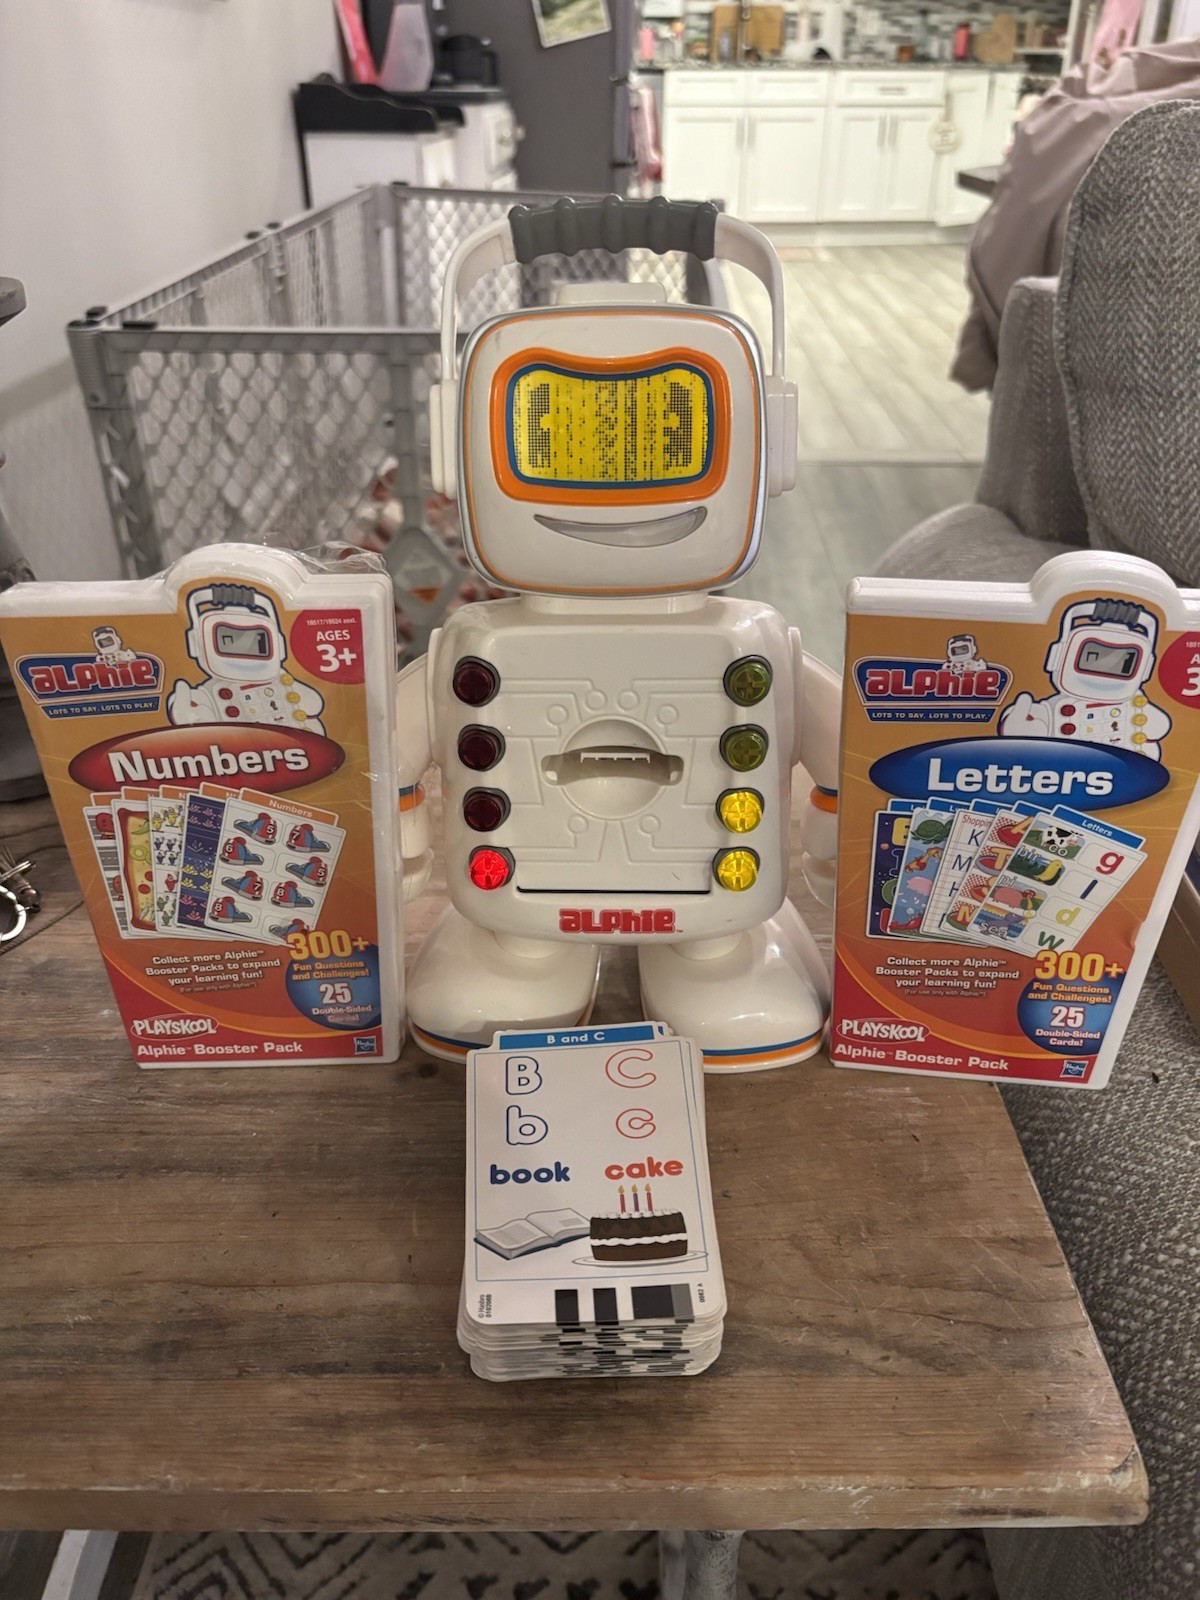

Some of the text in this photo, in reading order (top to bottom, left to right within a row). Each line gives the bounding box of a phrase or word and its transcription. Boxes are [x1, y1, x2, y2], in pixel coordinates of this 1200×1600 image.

[316, 629, 351, 641] AGES
[316, 644, 357, 672] 3+
[49, 707, 68, 715] LOTS
[101, 704, 120, 712] LOTS
[108, 744, 309, 783] Numbers
[927, 757, 1114, 796] Letters
[268, 799, 313, 819] Numbers
[266, 825, 274, 834] 5
[962, 814, 992, 828] Shoppin
[1081, 819, 1113, 837] Letters
[292, 831, 300, 839] 7
[967, 828, 984, 847] K
[225, 844, 233, 853] 6
[951, 854, 973, 873] M
[1095, 851, 1125, 875] g
[318, 868, 325, 877] 5
[254, 882, 261, 891] 7
[277, 888, 284, 897] 8
[214, 903, 222, 912] 8
[1055, 906, 1081, 927] d
[286, 929, 369, 960] 300+
[145, 959, 281, 976] Booster Packs to expand
[152, 955, 190, 965] Collect
[193, 953, 221, 962] more
[293, 960, 365, 971] Fun Questions
[887, 956, 927, 966] Collect
[930, 958, 960, 966] more
[1034, 950, 1123, 982] 300+
[168, 970, 263, 987] your learning fun!
[292, 968, 370, 980] and Challenges!
[875, 966, 1019, 980] Booster Packs to expand
[896, 978, 996, 989] your learning fun!
[1033, 982, 1110, 994] Fun Questions
[319, 982, 352, 1004] 25
[1027, 992, 1112, 1004] and Challenges!
[311, 1004, 372, 1016] Double-Sided
[1049, 1005, 1085, 1028] 25
[133, 1018, 217, 1036] PLAYSKOOL
[841, 1018, 926, 1043] PLAYSKOOL
[1035, 1028, 1101, 1039] Double-Sided
[546, 1031, 606, 1044] B and C
[1049, 1038, 1083, 1047] Cards!
[193, 1043, 258, 1055] Booster
[263, 1041, 303, 1053] Pack
[605, 1048, 657, 1089] C
[894, 1049, 963, 1066] Booster
[968, 1056, 1009, 1071] Pack
[505, 1055, 543, 1096] B
[506, 1104, 549, 1146] b
[615, 1108, 656, 1140] c
[489, 1161, 571, 1185] book
[604, 1156, 684, 1180] cake
